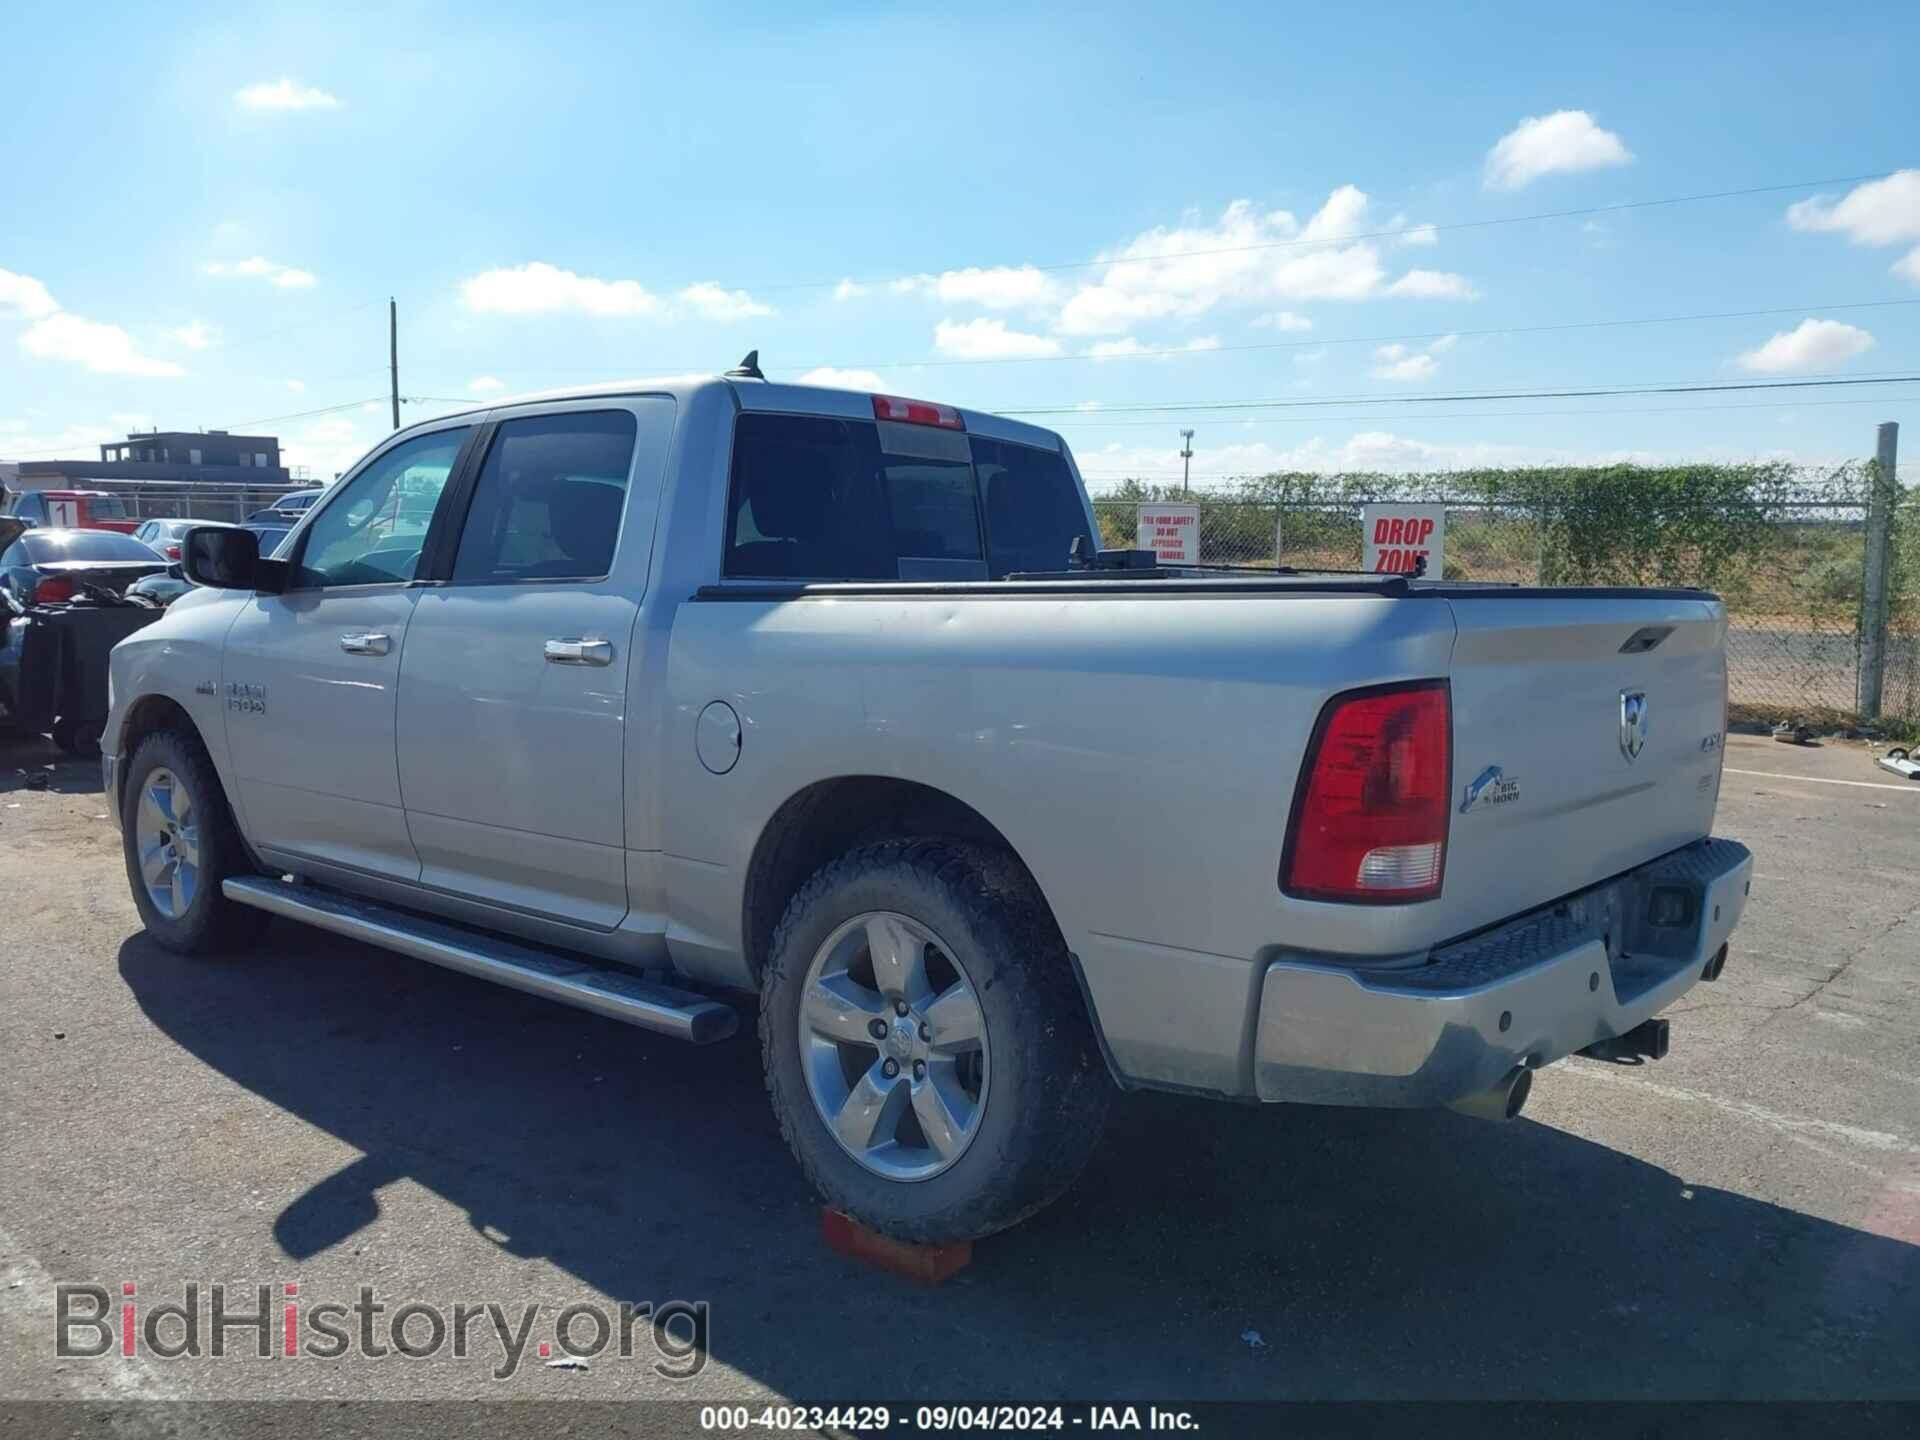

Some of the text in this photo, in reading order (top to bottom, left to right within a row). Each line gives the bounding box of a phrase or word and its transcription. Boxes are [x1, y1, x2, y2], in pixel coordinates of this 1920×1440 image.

[1173, 515, 1194, 526] SAFETY
[1374, 518, 1434, 545] DROP
[1501, 781, 1518, 793] BIG
[1493, 791, 1520, 805] HORN
